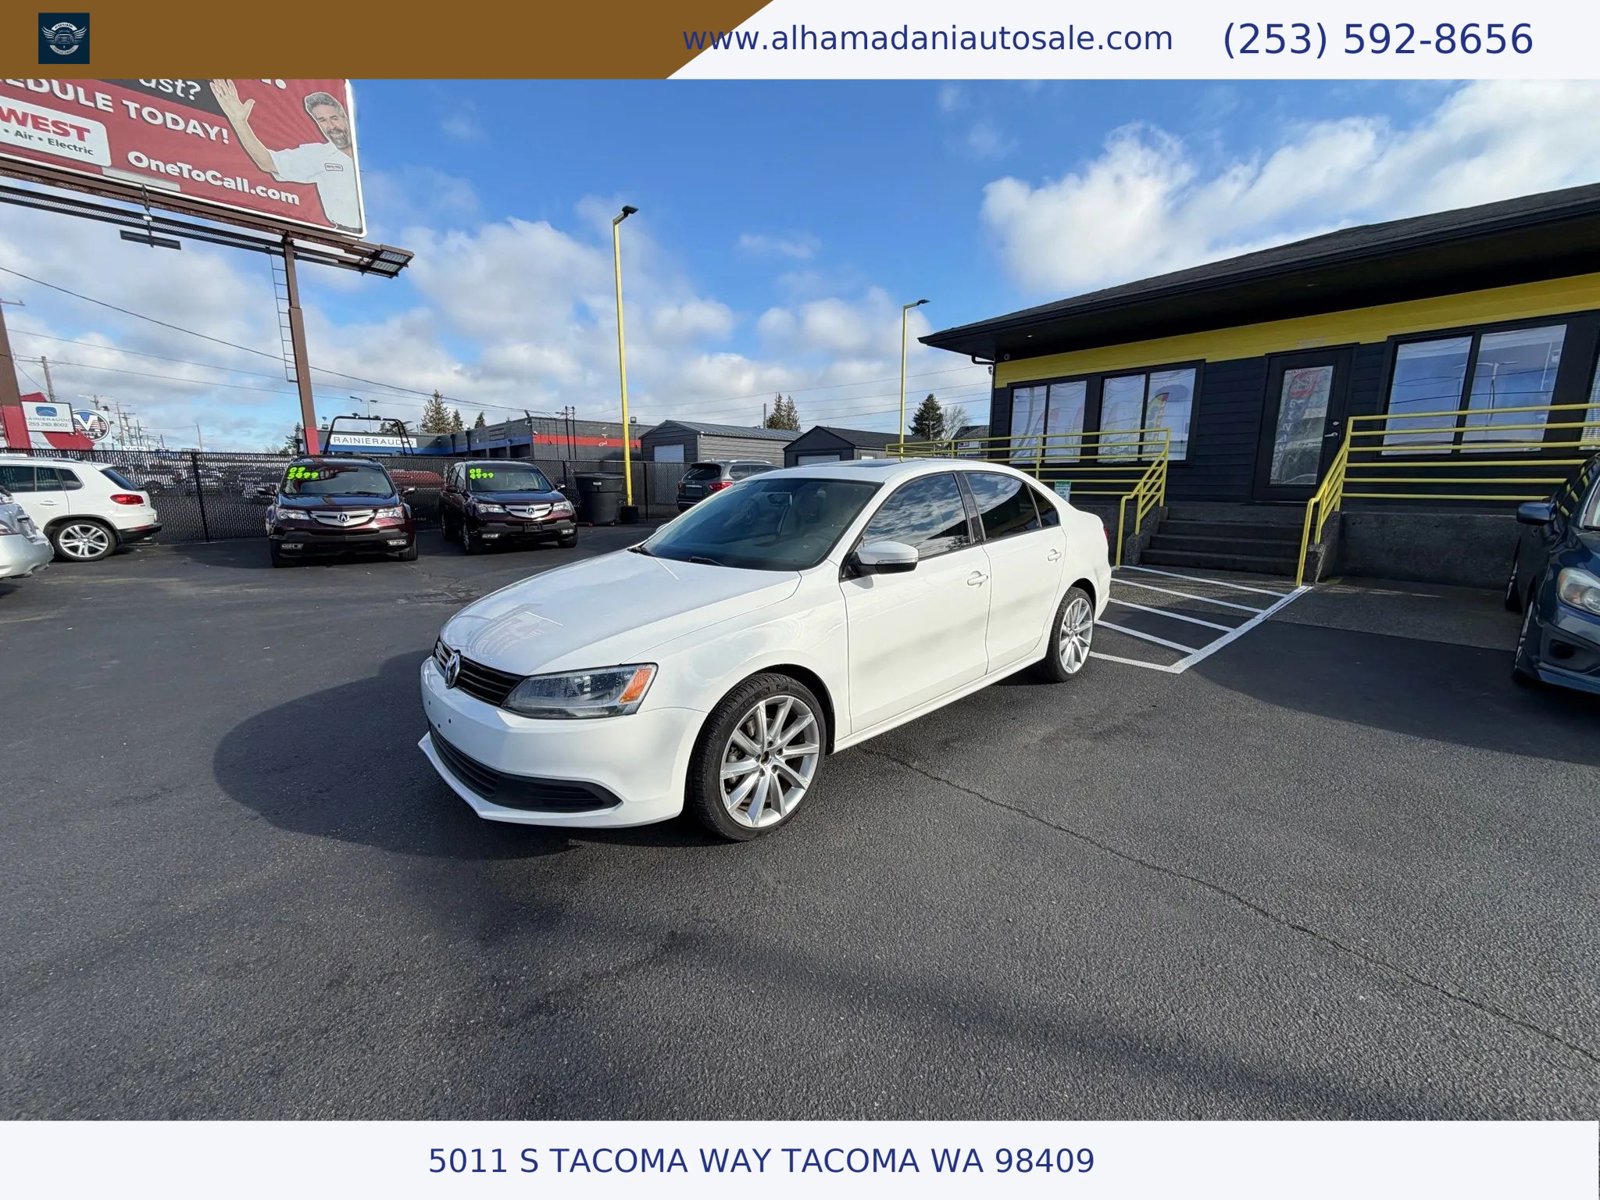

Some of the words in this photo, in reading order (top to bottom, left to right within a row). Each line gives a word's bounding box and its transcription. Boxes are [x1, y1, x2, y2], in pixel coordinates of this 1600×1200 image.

[122, 100, 229, 144] TODAY!
[14, 130, 34, 141] Air
[47, 138, 94, 156] Electric
[127, 151, 300, 205] OneToCall.com
[333, 436, 414, 446] RAINIERAUDO
